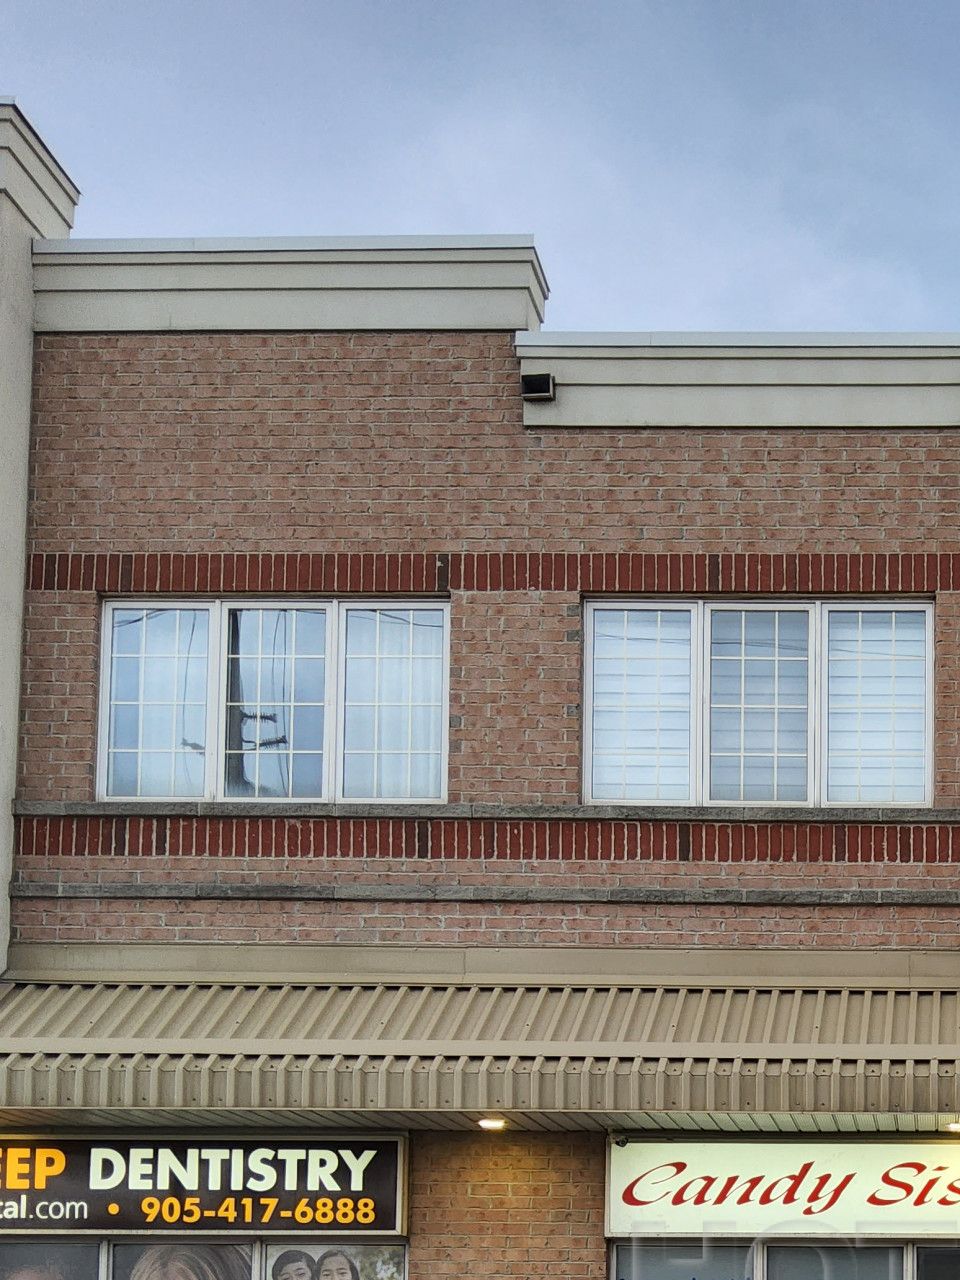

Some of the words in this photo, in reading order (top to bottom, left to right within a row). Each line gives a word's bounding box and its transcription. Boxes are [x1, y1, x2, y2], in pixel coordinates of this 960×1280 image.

[0, 1148, 66, 1190] EP
[89, 1148, 378, 1192] DENTISTRY
[622, 1160, 857, 1216] Candy
[0, 1194, 88, 1219] al.com
[141, 1197, 376, 1224] 905-417-6888
